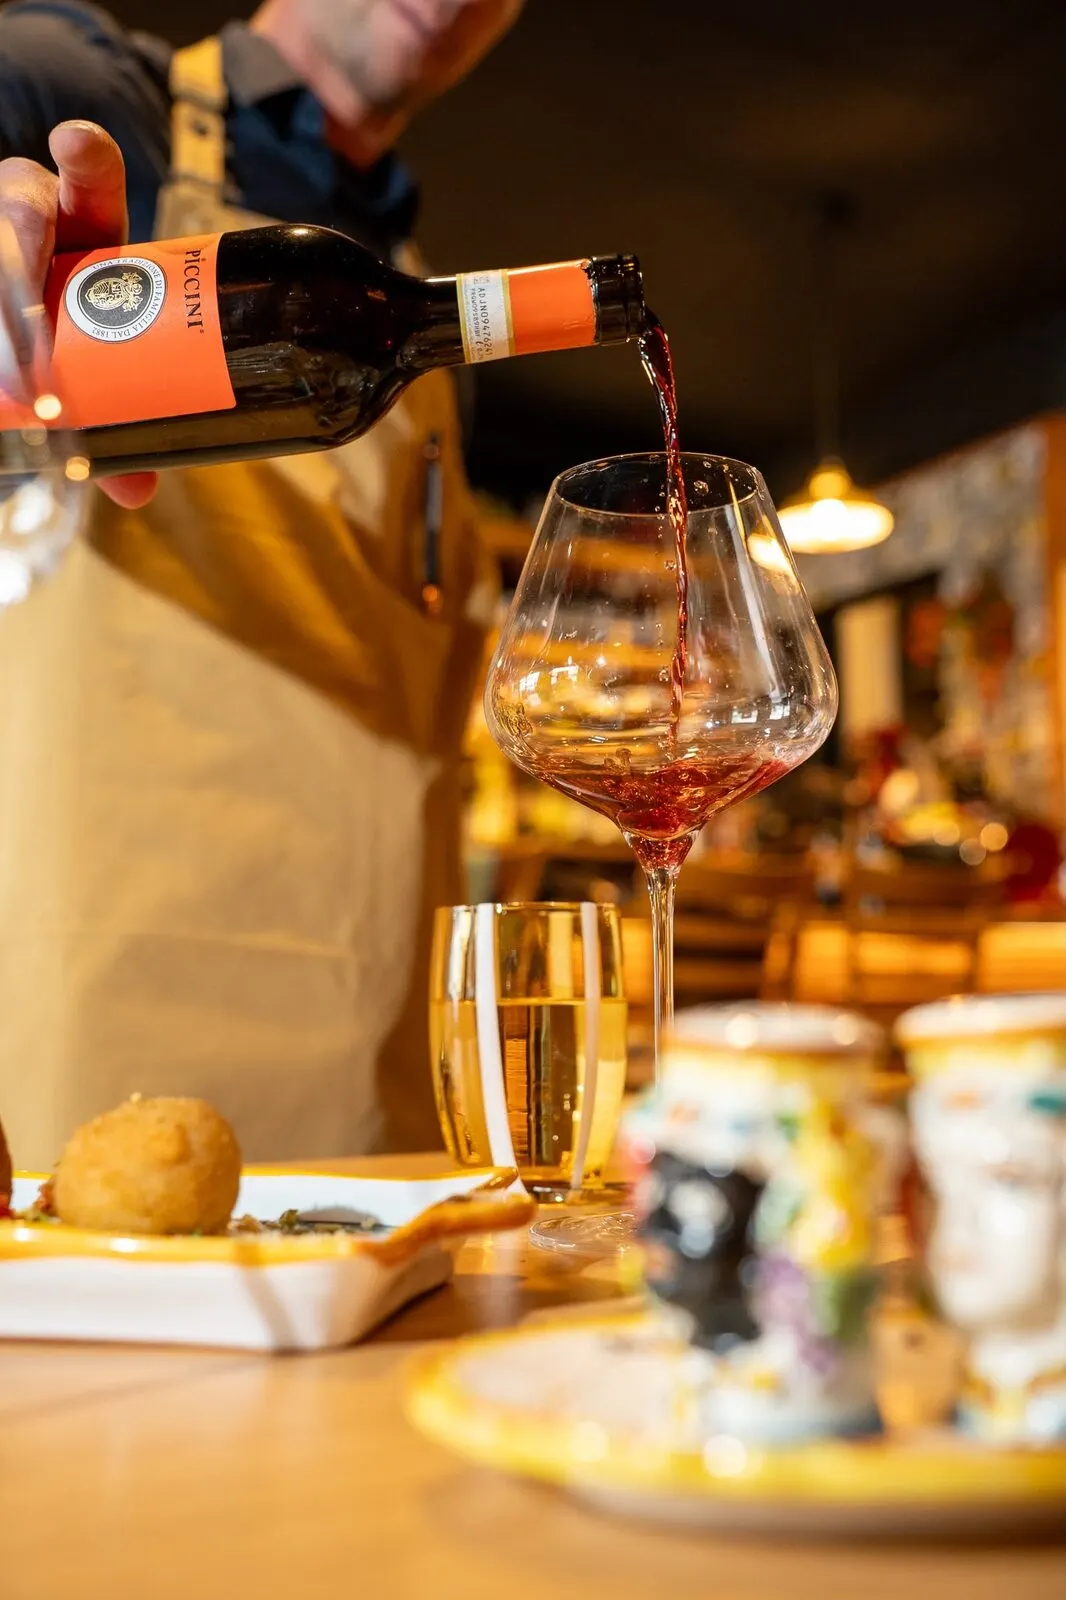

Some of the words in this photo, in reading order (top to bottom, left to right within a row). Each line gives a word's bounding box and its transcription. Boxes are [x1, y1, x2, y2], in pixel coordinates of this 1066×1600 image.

[92, 260, 113, 270] UNA
[155, 279, 163, 290] DI
[132, 290, 162, 332] FAMIGLIA
[91, 326, 110, 338] 1882
[112, 328, 131, 339] DAL
